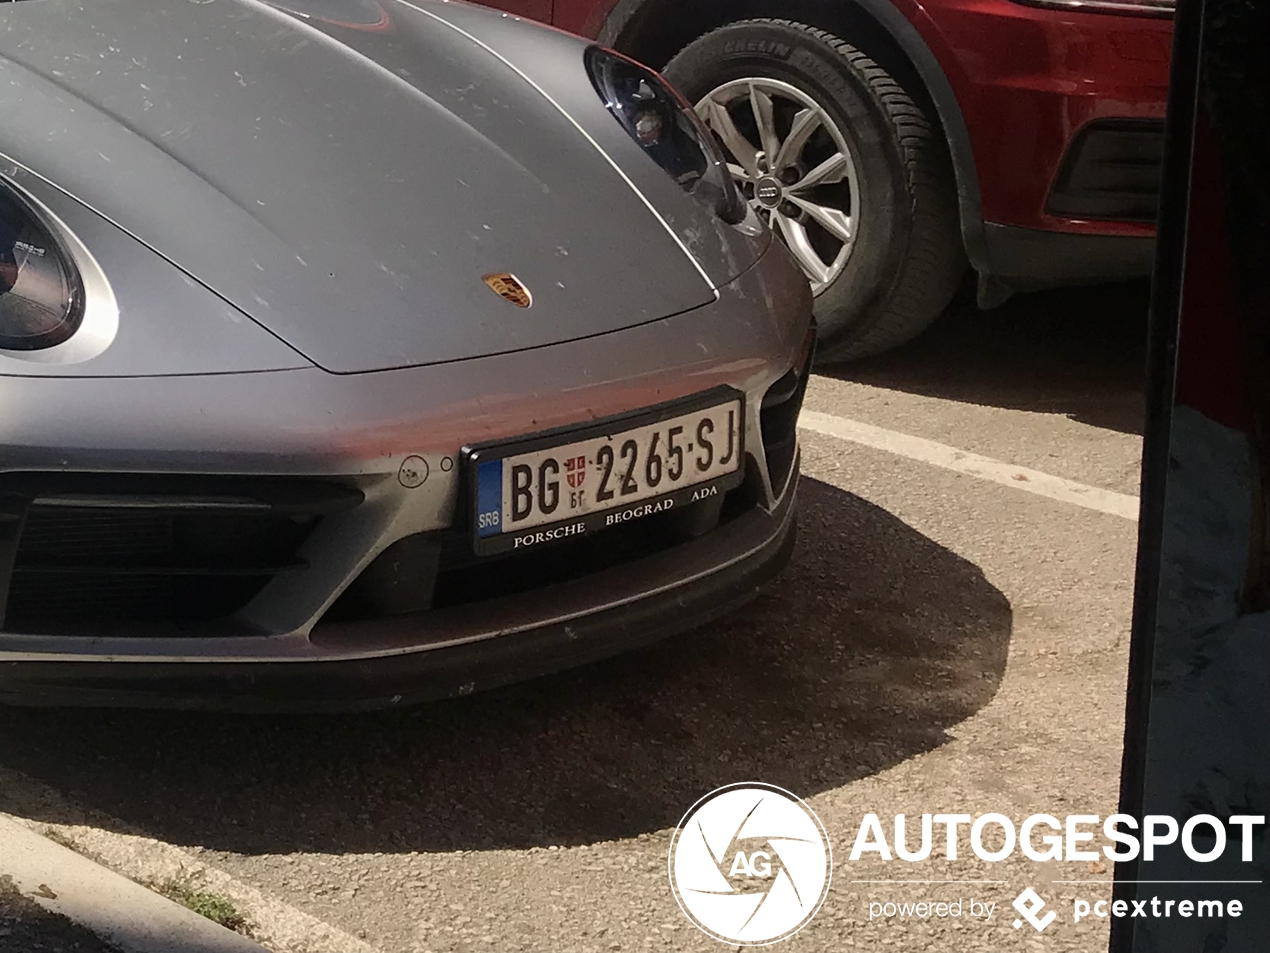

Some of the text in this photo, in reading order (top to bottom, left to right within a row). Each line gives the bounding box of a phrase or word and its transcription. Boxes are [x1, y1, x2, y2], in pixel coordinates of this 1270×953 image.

[478, 510, 500, 529] SRB
[510, 461, 560, 522] BG
[513, 484, 719, 548] PORSCHE BEOGRAD ADA
